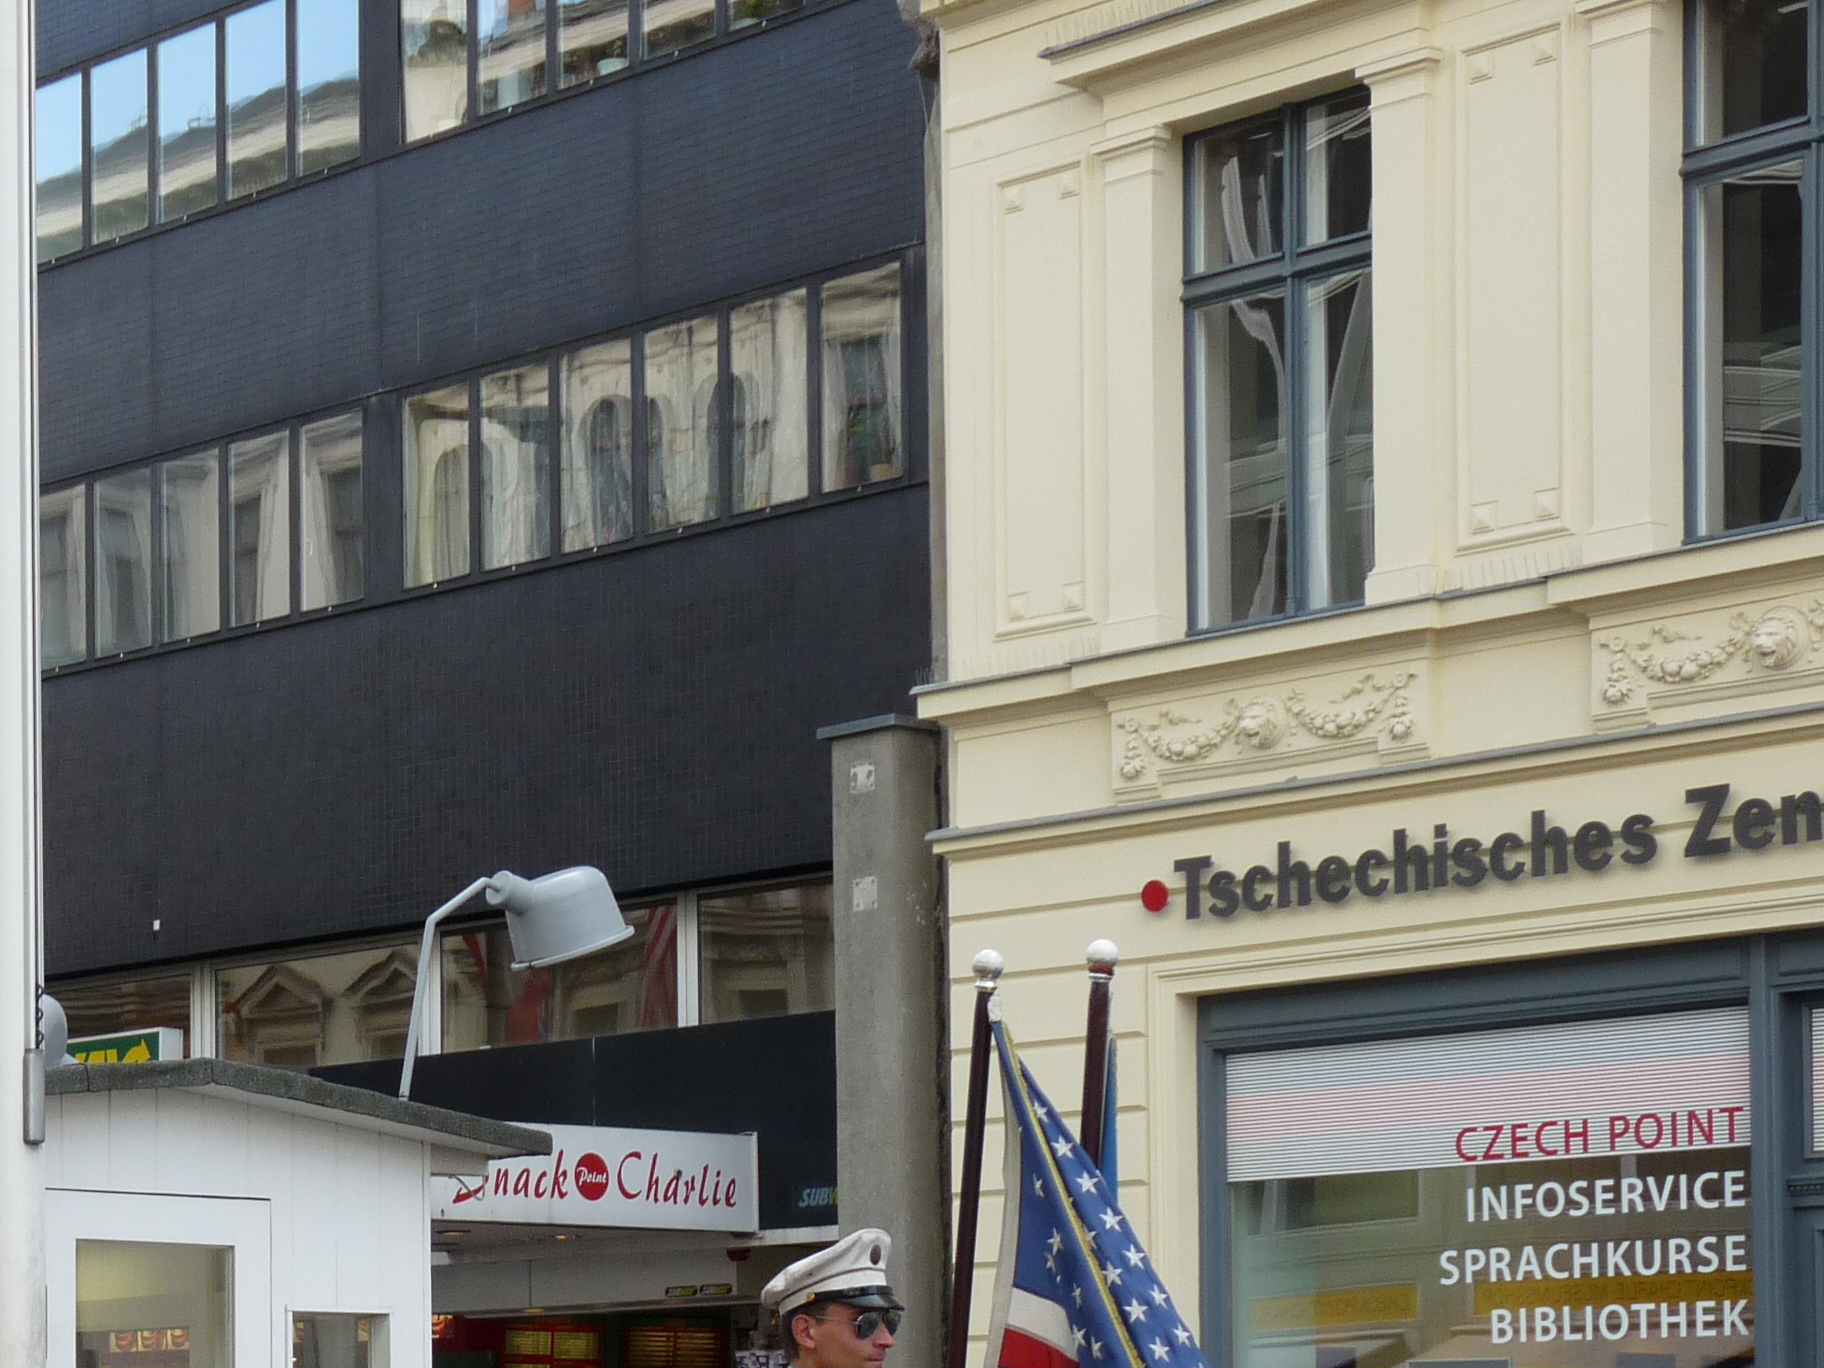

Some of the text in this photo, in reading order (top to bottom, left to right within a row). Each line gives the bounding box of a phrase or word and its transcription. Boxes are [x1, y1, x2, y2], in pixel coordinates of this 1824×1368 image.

[1173, 782, 1824, 920] Tschechisches Zen
[1455, 1105, 1744, 1162] CZECH POINT
[577, 1165, 608, 1187] Point
[616, 1151, 738, 1208] Charlie
[1466, 1169, 1746, 1223] INFOSERVICE
[1439, 1234, 1747, 1286] SPRACHKURSE
[1490, 1299, 1749, 1344] BIBLIOTHEK
